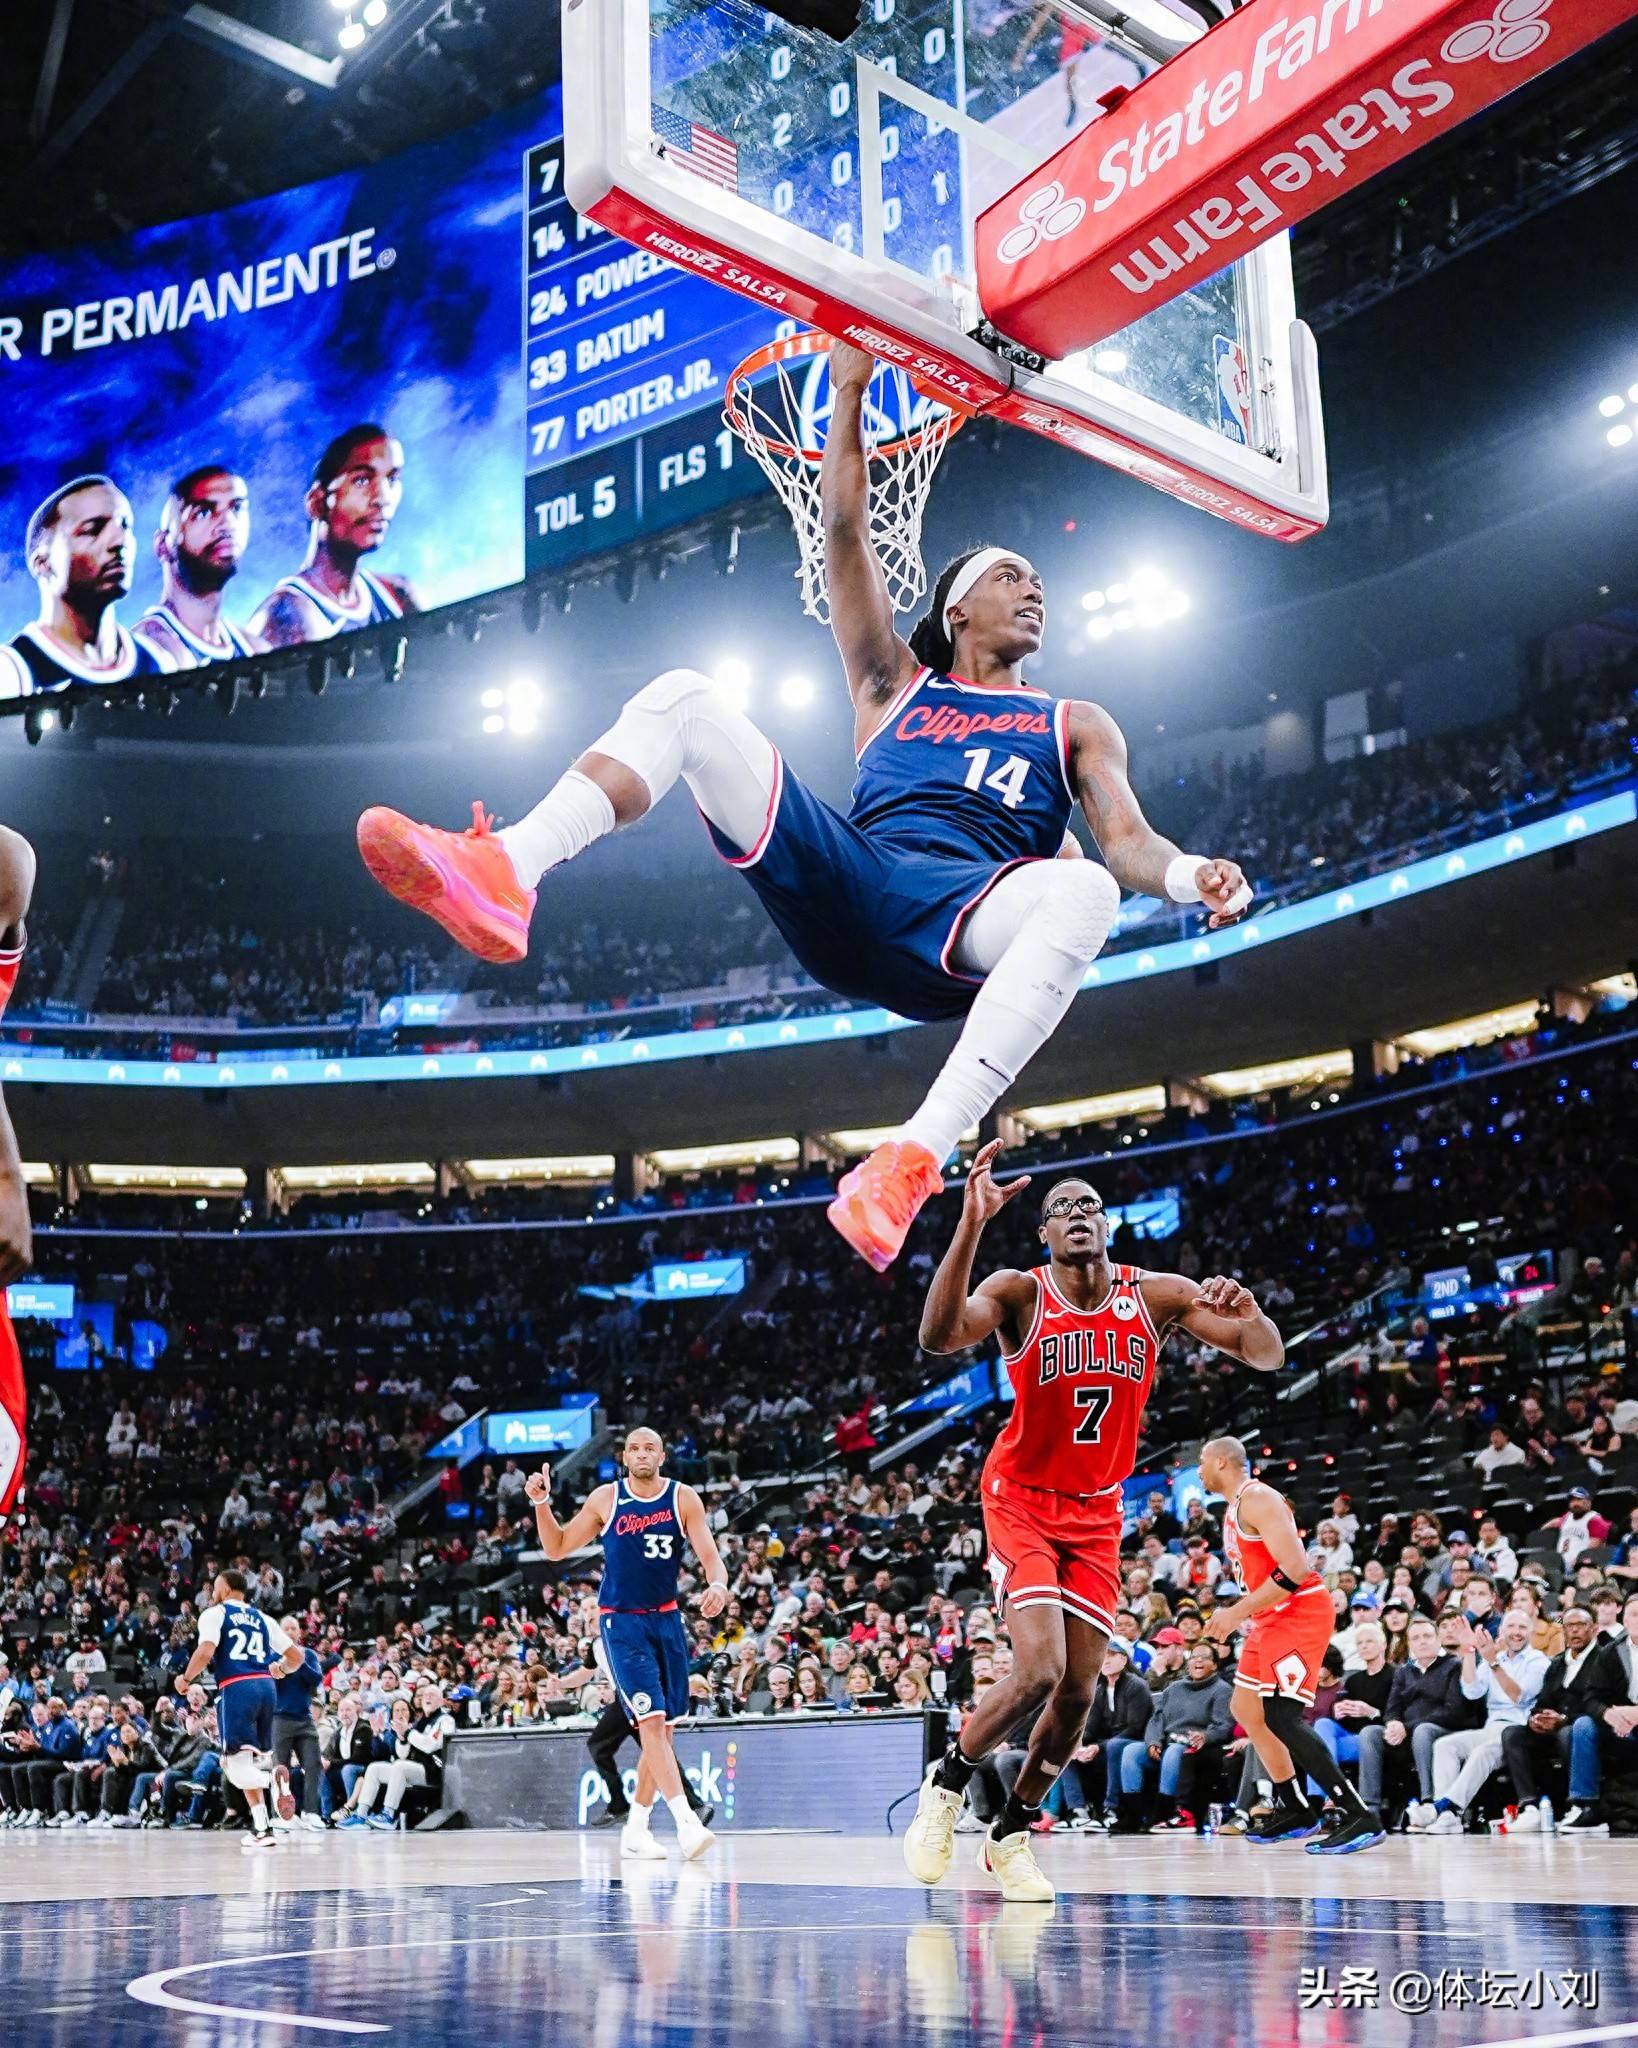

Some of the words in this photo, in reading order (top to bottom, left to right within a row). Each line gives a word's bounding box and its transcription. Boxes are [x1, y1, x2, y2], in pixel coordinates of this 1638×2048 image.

[540, 159, 559, 193] 7
[532, 221, 565, 258] 14
[645, 231, 727, 272] HERDEZ
[721, 267, 789, 305] SALSA
[530, 285, 568, 326] 24
[529, 349, 567, 391] 33
[576, 308, 665, 373] BATUM
[843, 324, 914, 362] HERDEZ
[911, 356, 970, 394] SALSA
[531, 415, 565, 456] 77
[576, 374, 674, 440] PORTER
[675, 358, 719, 400] JR.
[534, 492, 584, 536] TOL
[592, 474, 616, 519] 5
[659, 445, 706, 492] FLS
[715, 430, 733, 470] 1
[1229, 506, 1279, 532] SALSA
[896, 705, 1051, 744] Clippers
[963, 748, 1031, 809] 14
[1039, 1330, 1146, 1386] BULLS
[1073, 1386, 1113, 1444] 7
[615, 1509, 673, 1536] Clippers
[643, 1533, 674, 1560] 33
[228, 1628, 266, 1664] 24
